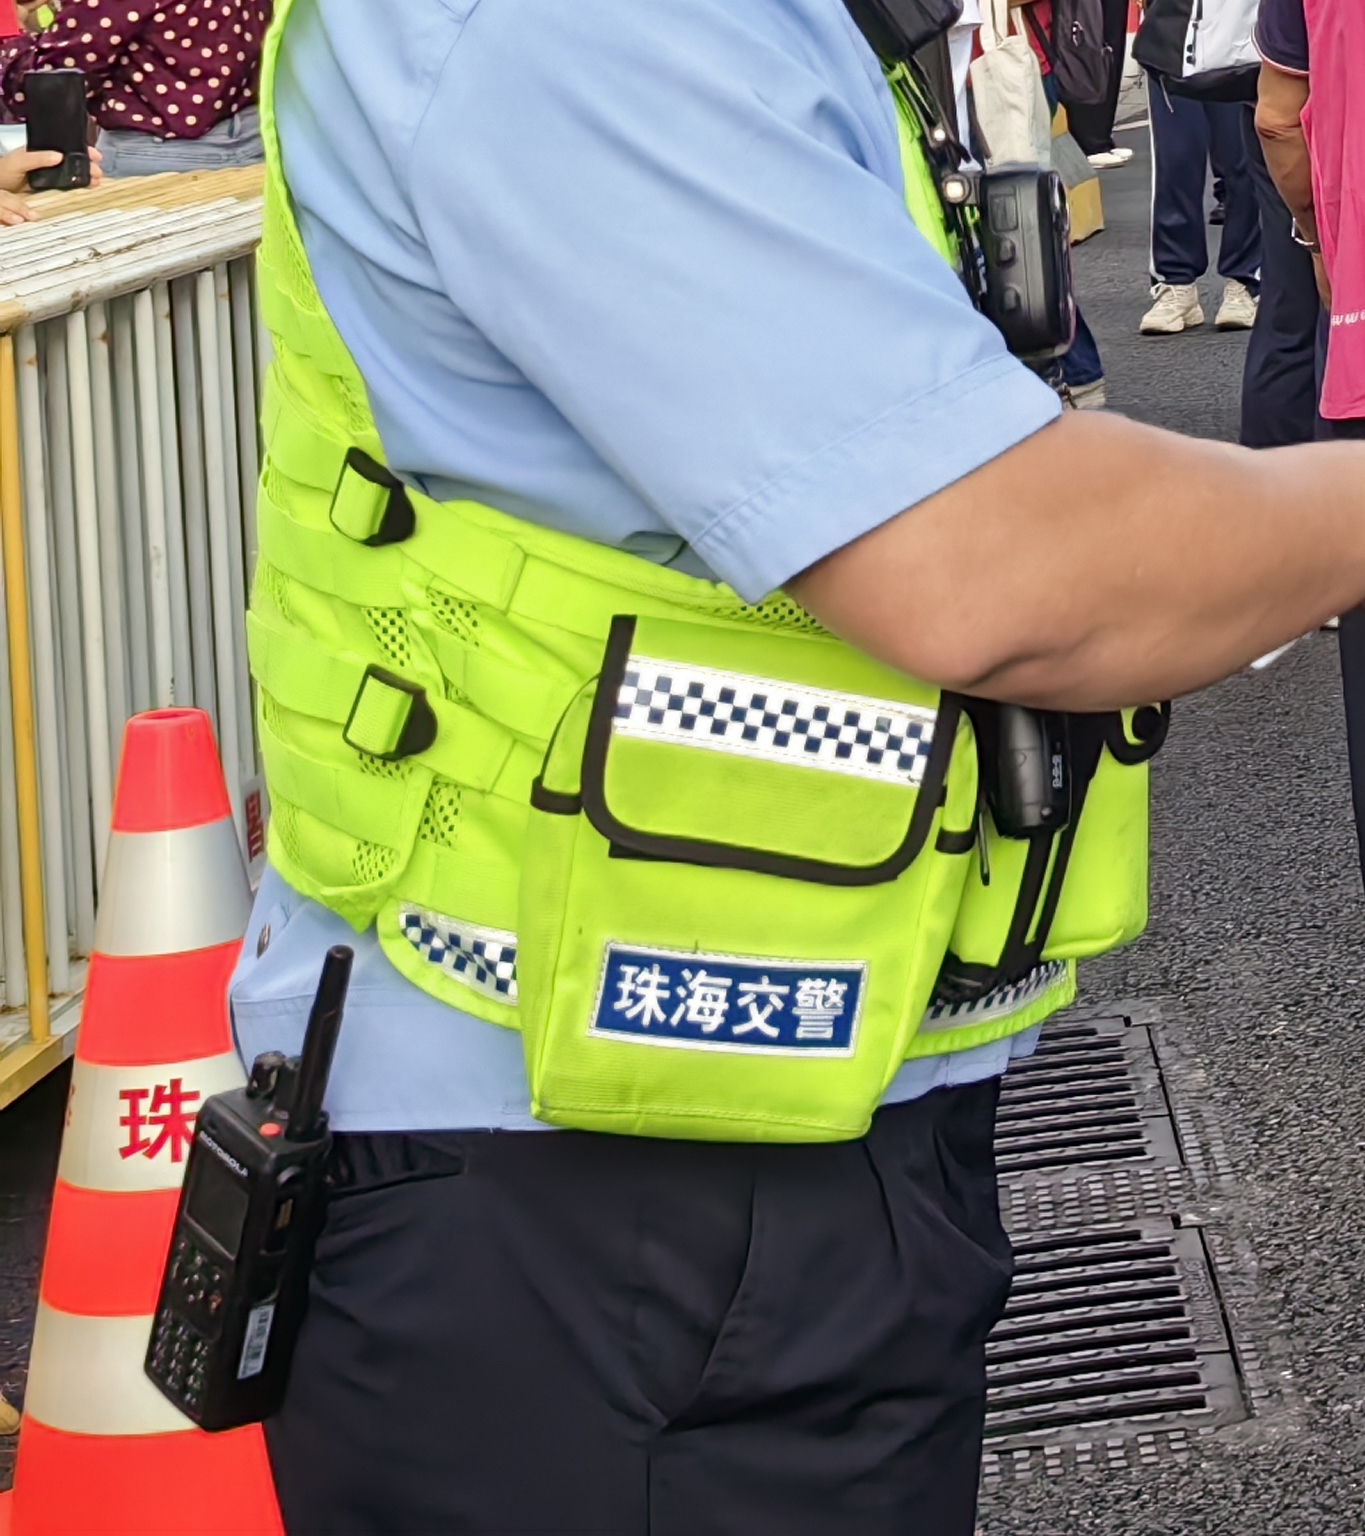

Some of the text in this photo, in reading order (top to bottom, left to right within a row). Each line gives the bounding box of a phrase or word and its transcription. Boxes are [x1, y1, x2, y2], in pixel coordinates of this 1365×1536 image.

[613, 963, 848, 1040] 珠海交警
[118, 1077, 201, 1164] 珠
